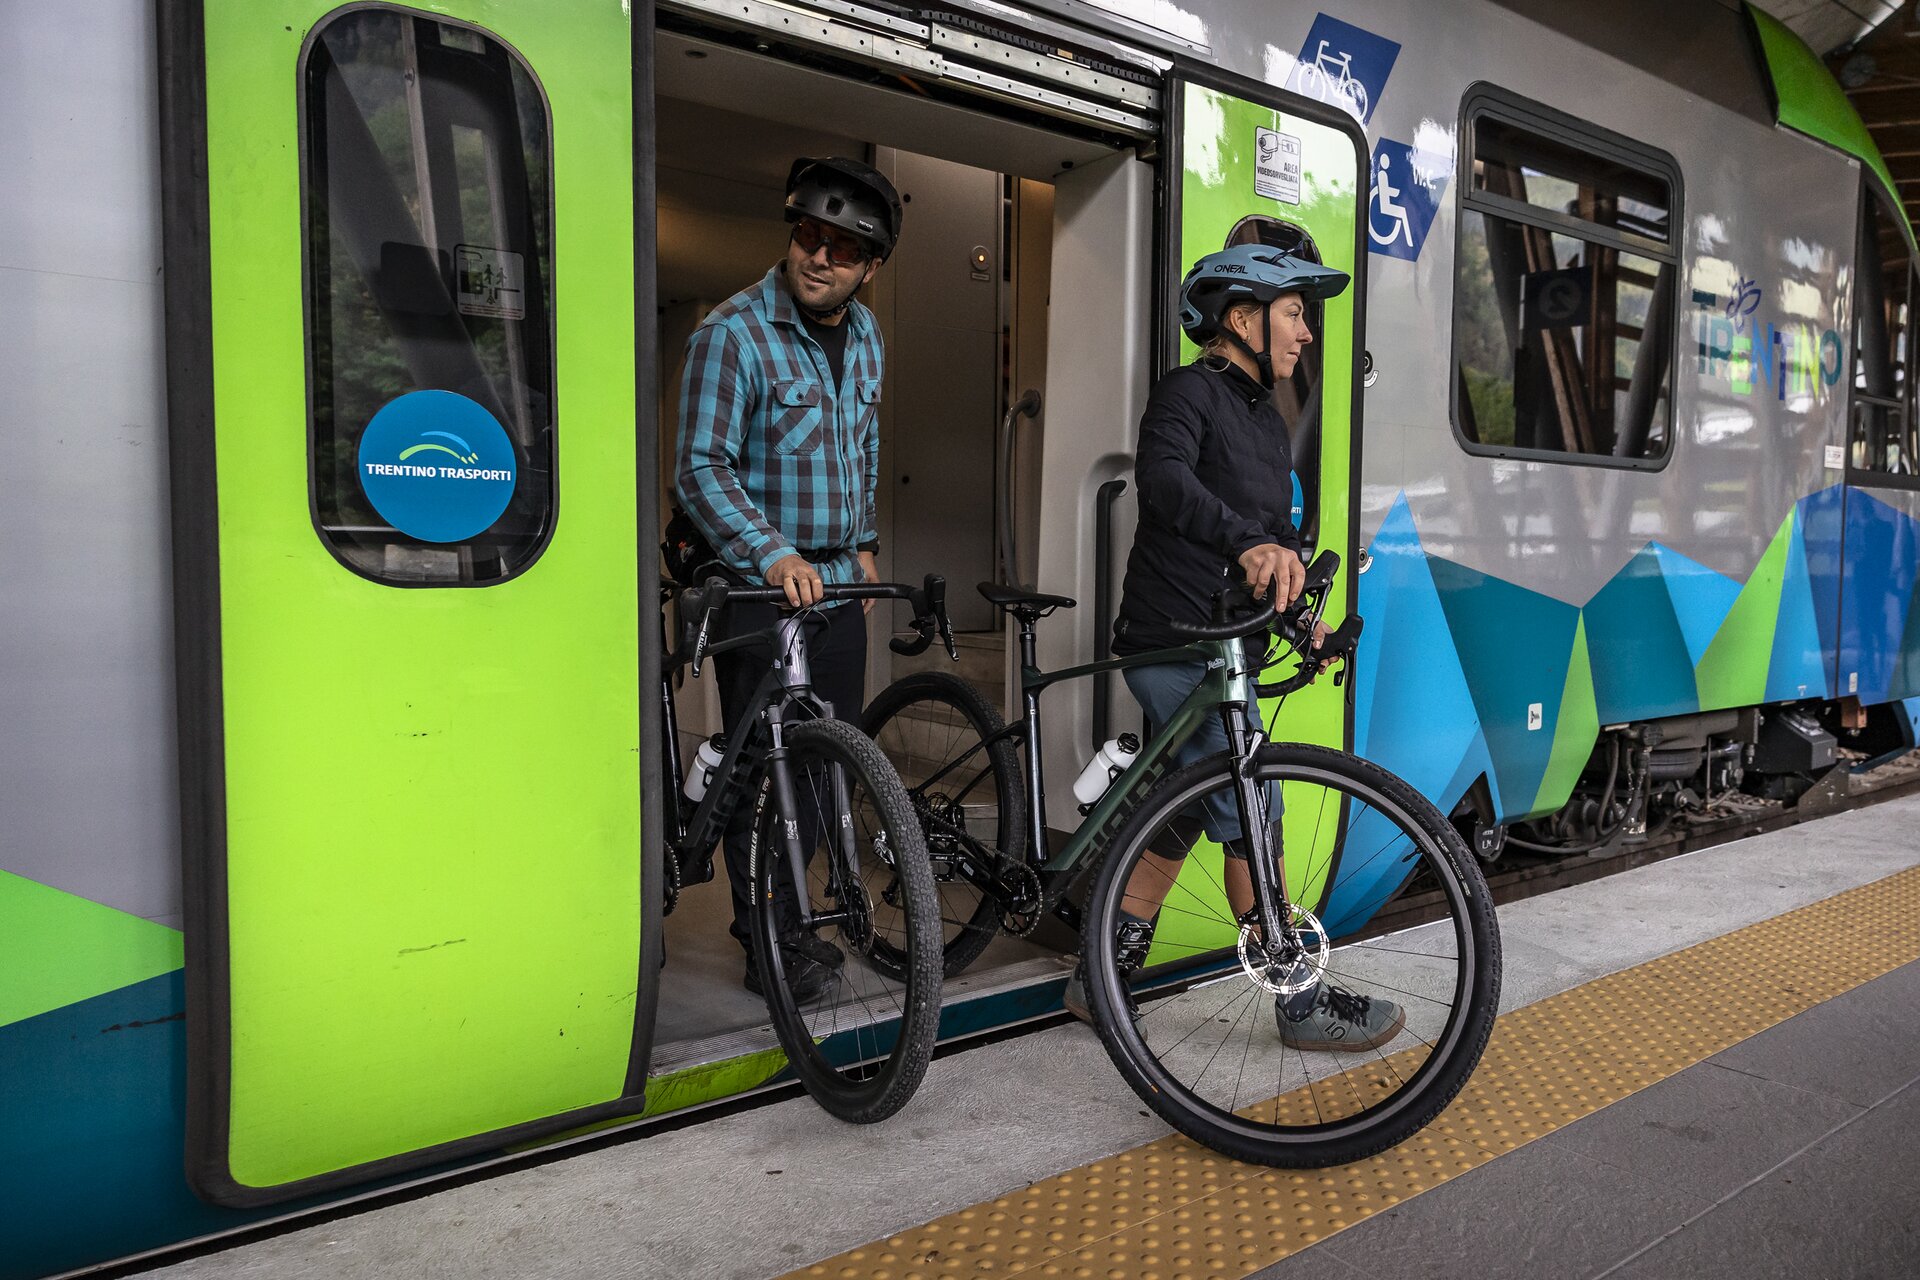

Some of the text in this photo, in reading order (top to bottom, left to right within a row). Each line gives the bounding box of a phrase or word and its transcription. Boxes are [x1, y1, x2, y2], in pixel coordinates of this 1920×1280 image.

[1283, 162, 1299, 176] AREA
[365, 463, 512, 481] TRENTINO TRASPORTI
